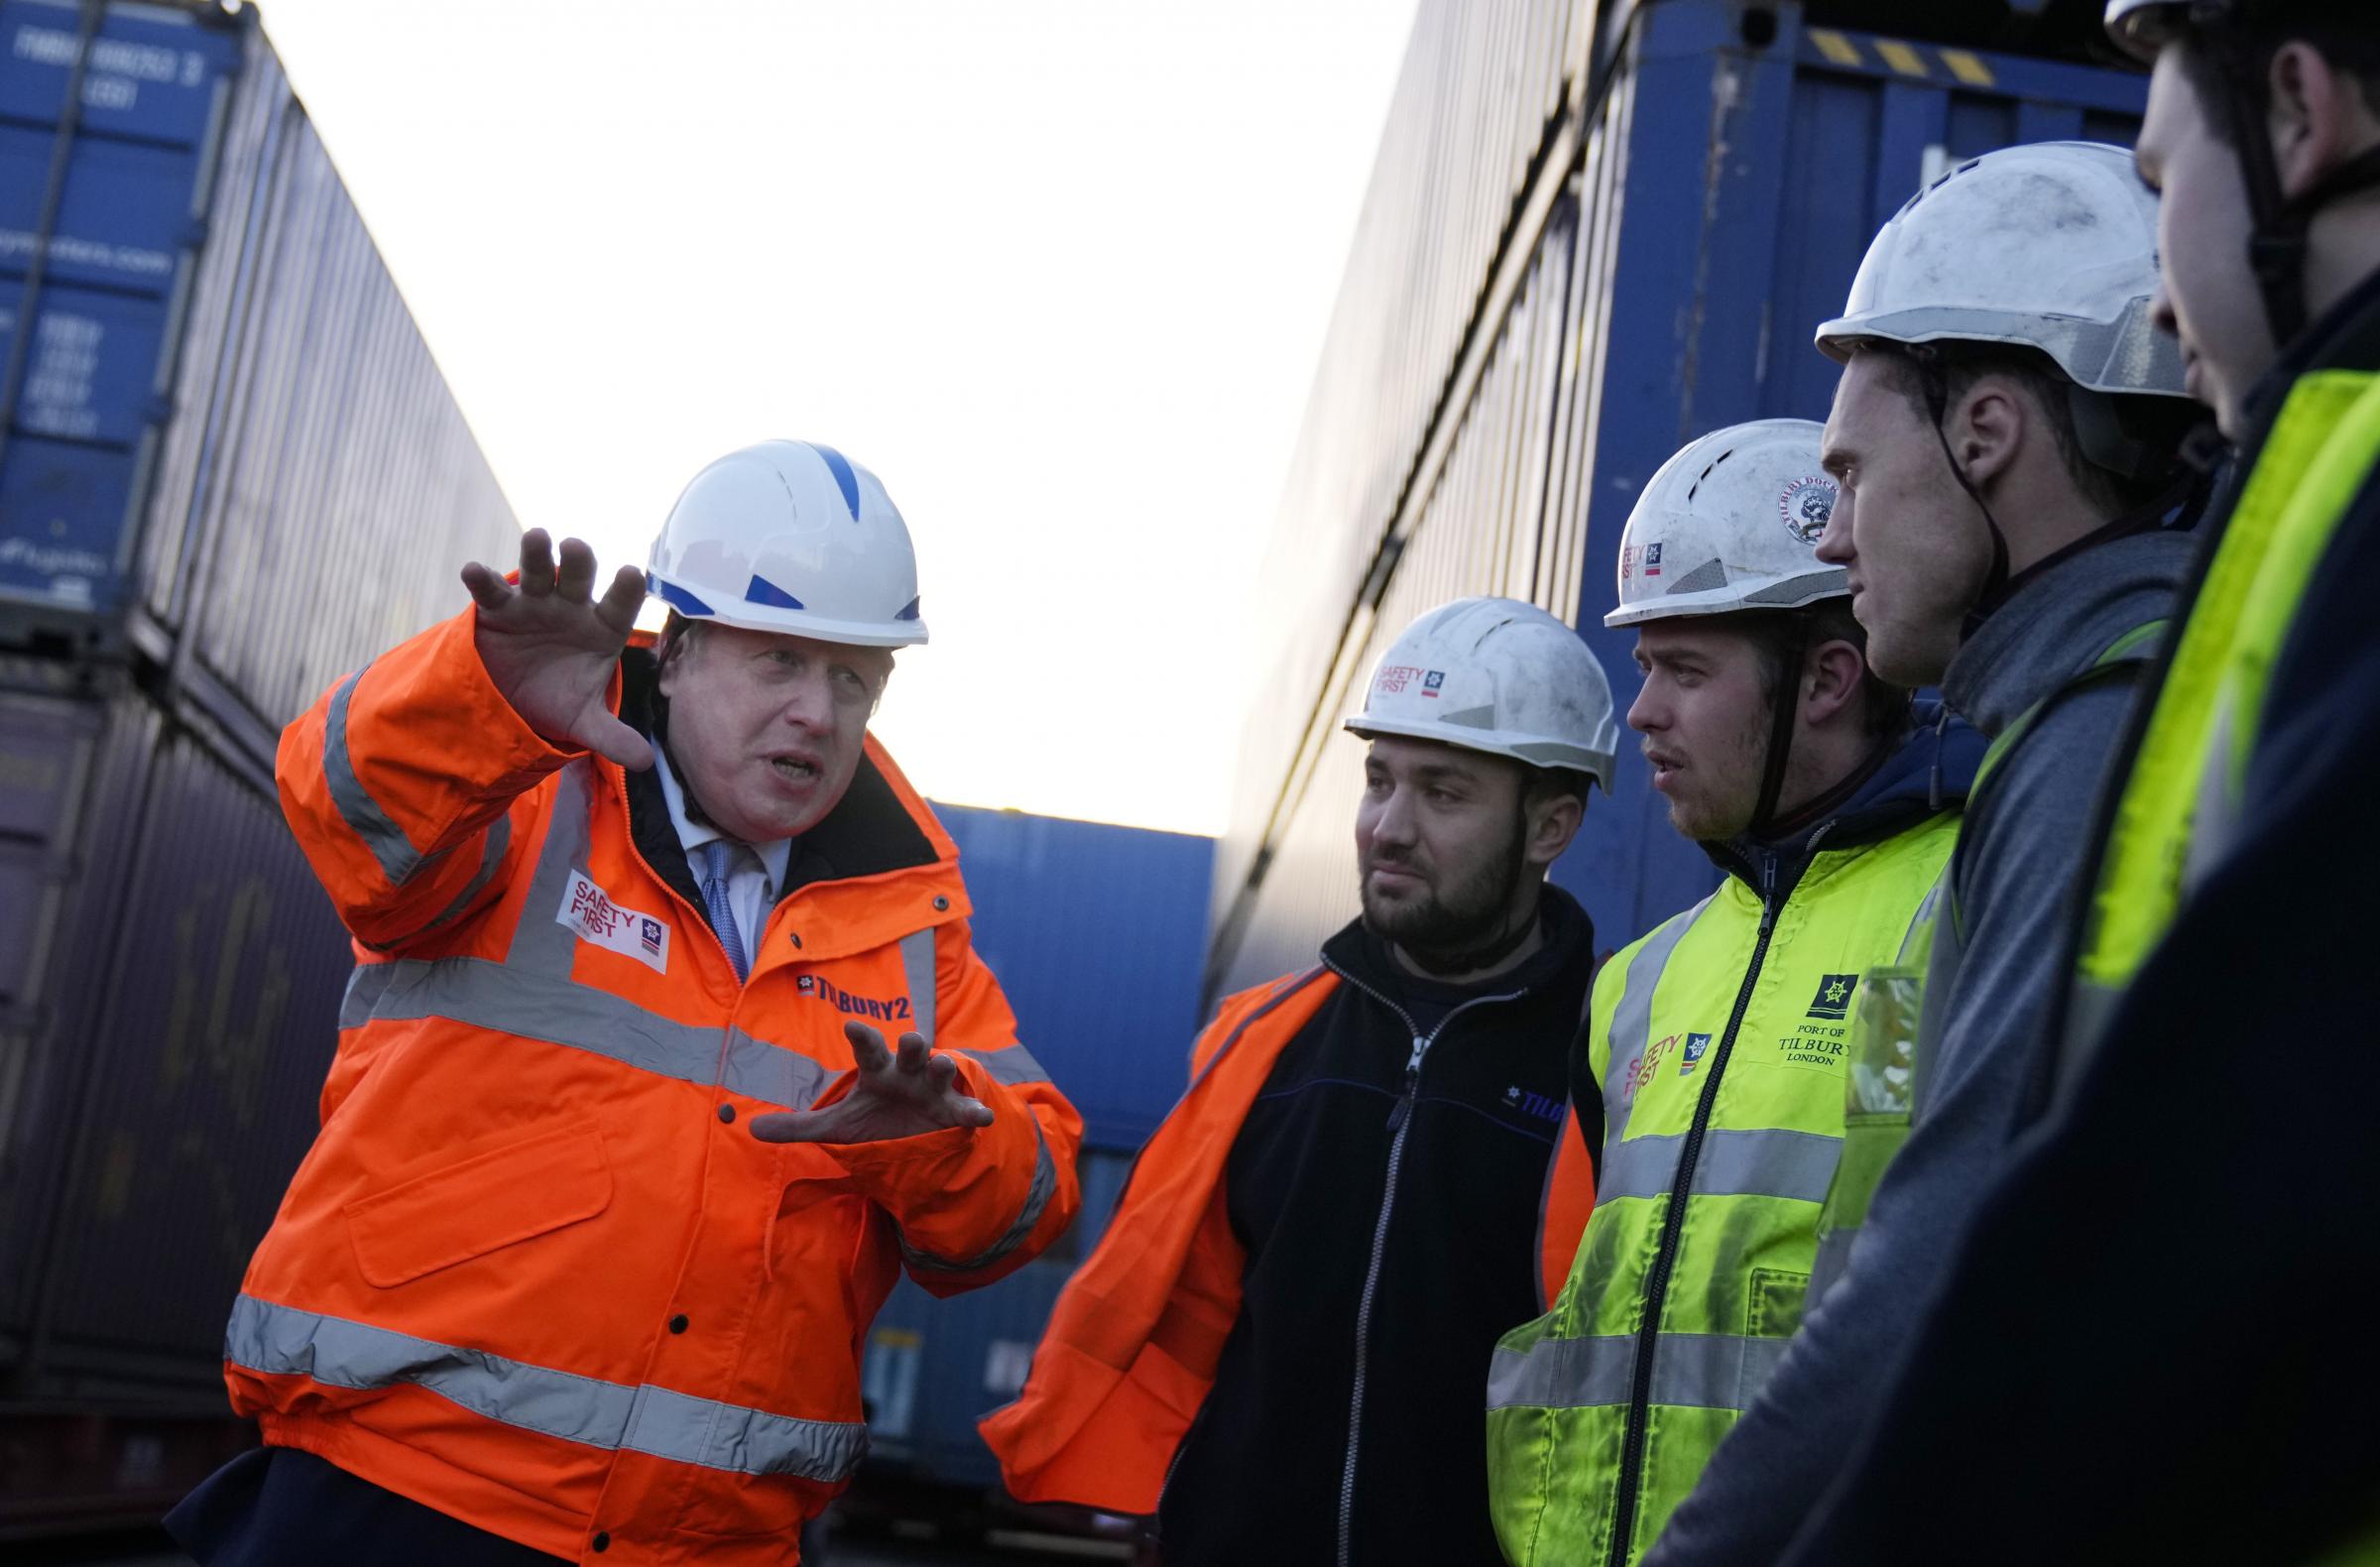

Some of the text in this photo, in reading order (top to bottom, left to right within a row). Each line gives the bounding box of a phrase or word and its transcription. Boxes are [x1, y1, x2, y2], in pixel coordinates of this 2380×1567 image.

[1379, 665, 1425, 681] SAFETY
[575, 880, 636, 928] SAFETY
[815, 975, 910, 1022] TILBURY2
[1797, 1025, 1845, 1037] PORT OF
[1786, 1052, 1836, 1066] LONDON
[1522, 1090, 1565, 1123] TILB
